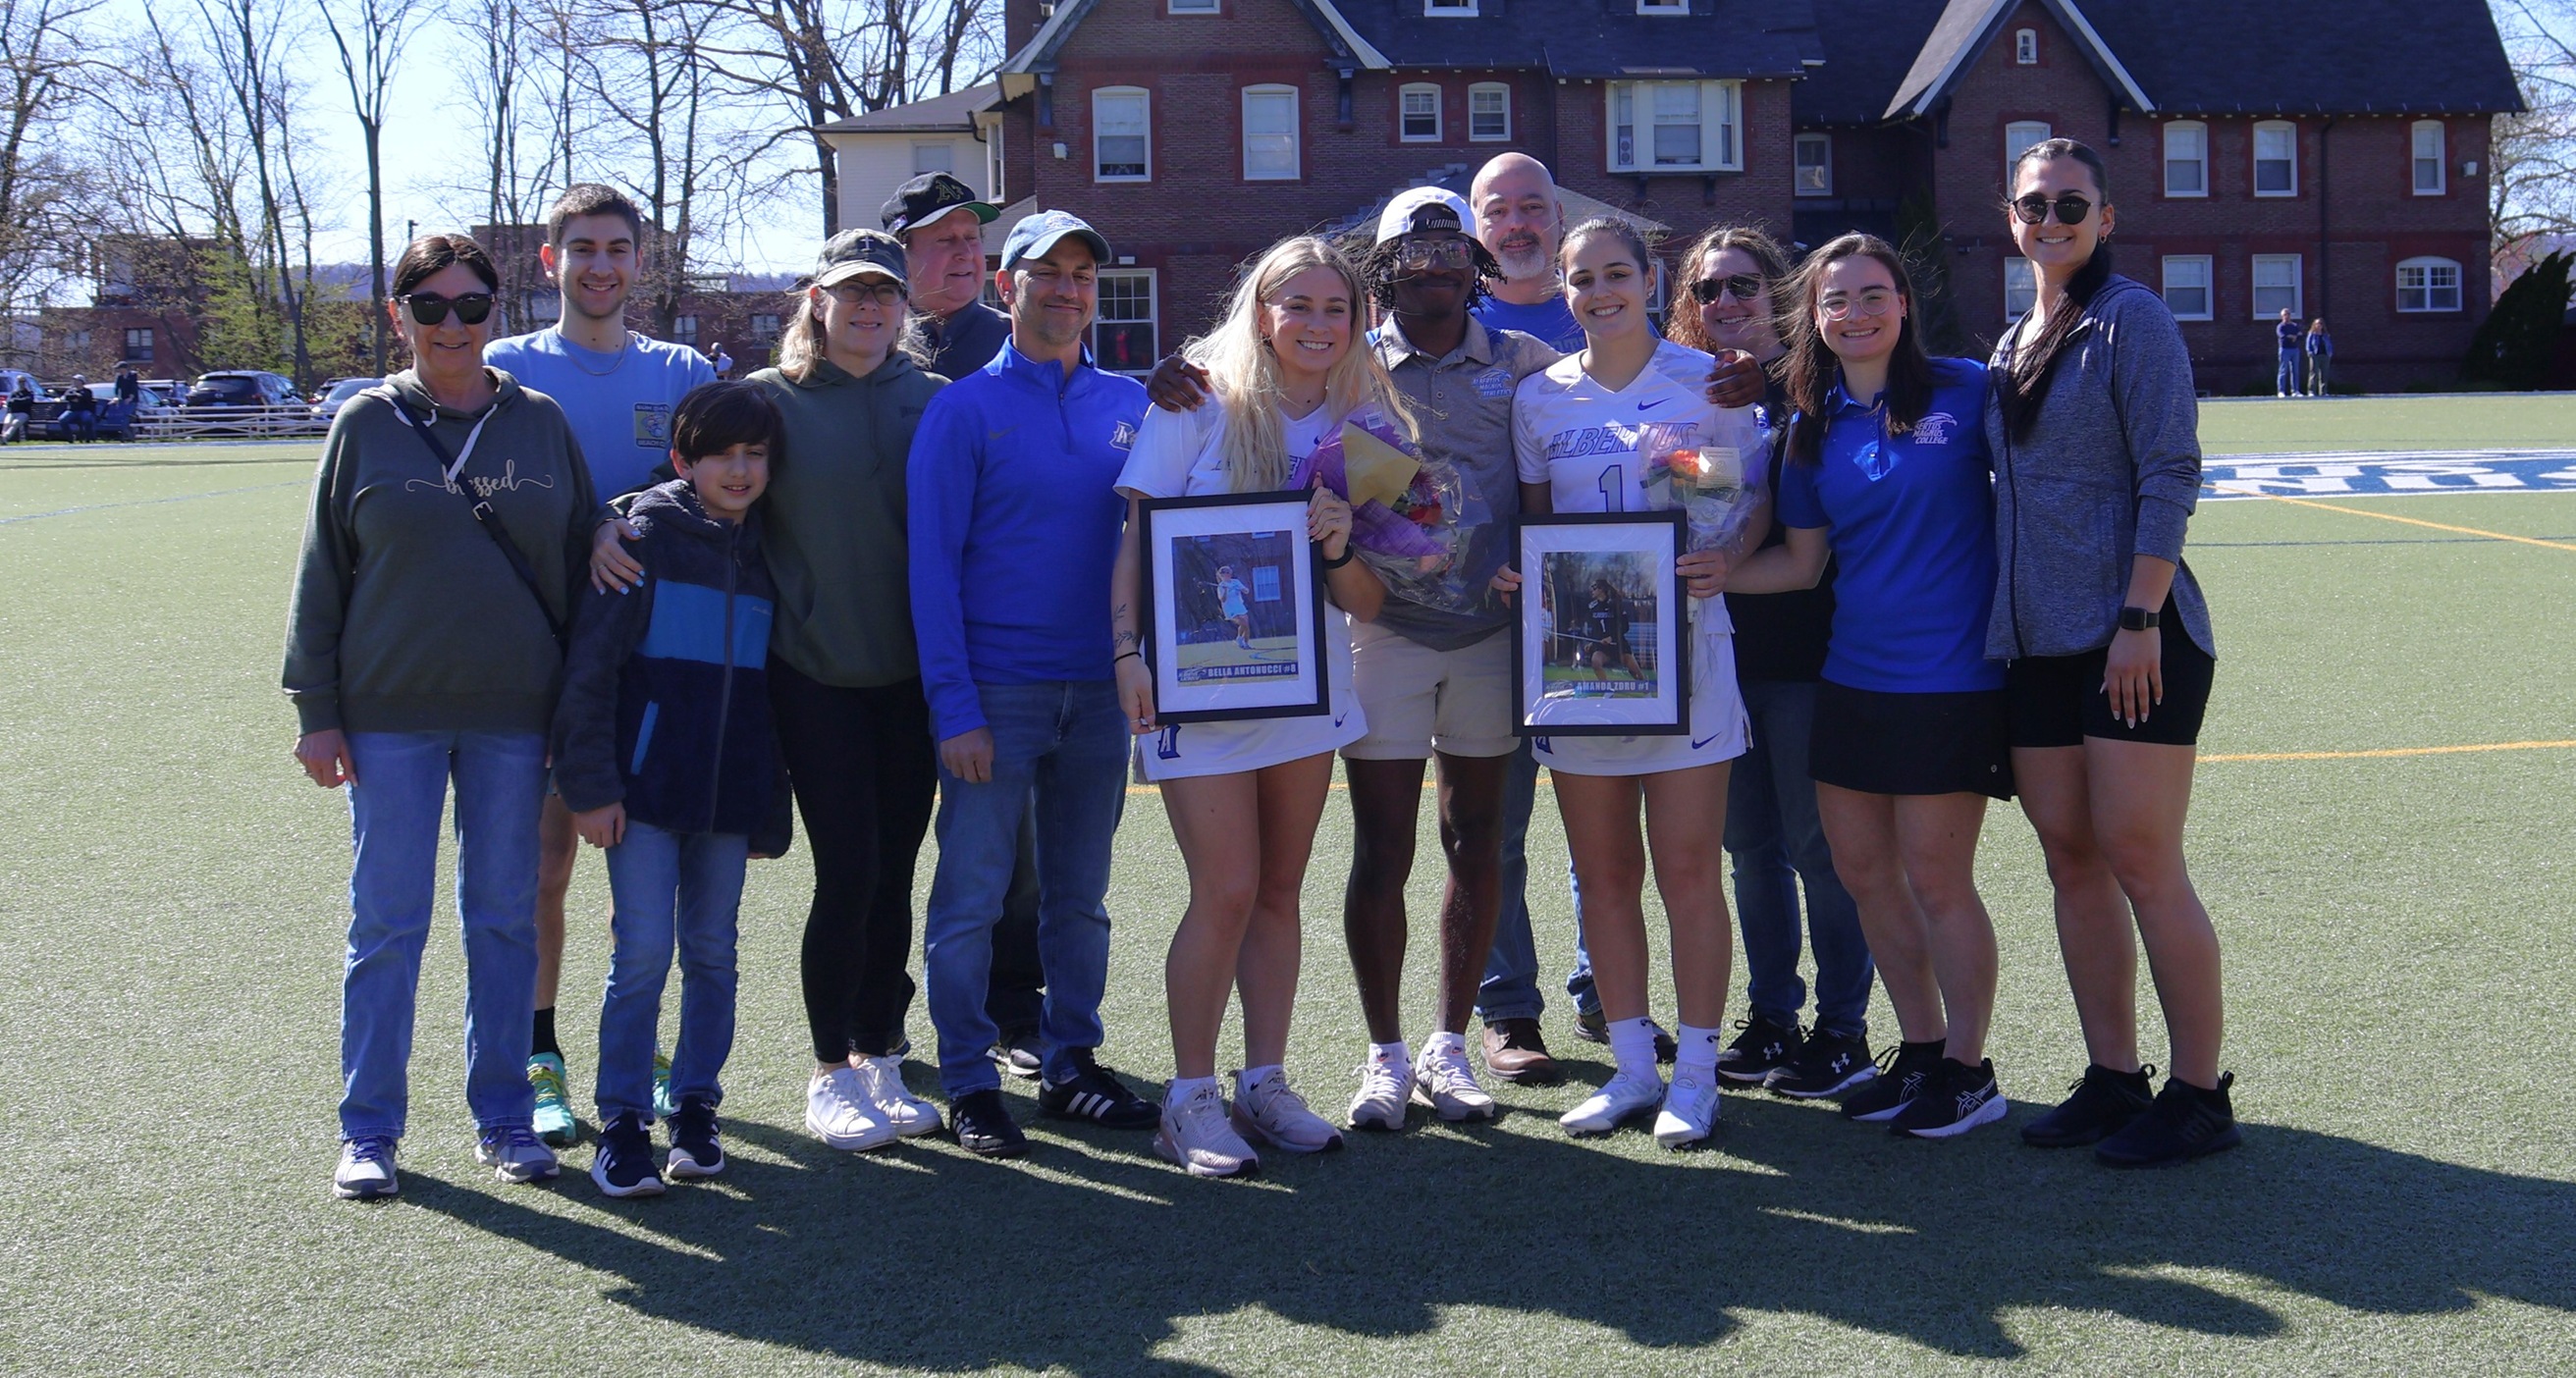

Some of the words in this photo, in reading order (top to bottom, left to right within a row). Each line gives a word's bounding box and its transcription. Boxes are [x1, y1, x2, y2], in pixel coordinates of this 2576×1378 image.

[1598, 464, 1624, 513] 1
[1208, 667, 1232, 677] BELLA
[1234, 664, 1282, 675] ANTONUCCI
[1284, 663, 1297, 673] #8
[1577, 681, 1612, 691] AMANDA
[1637, 681, 1650, 691] #1
